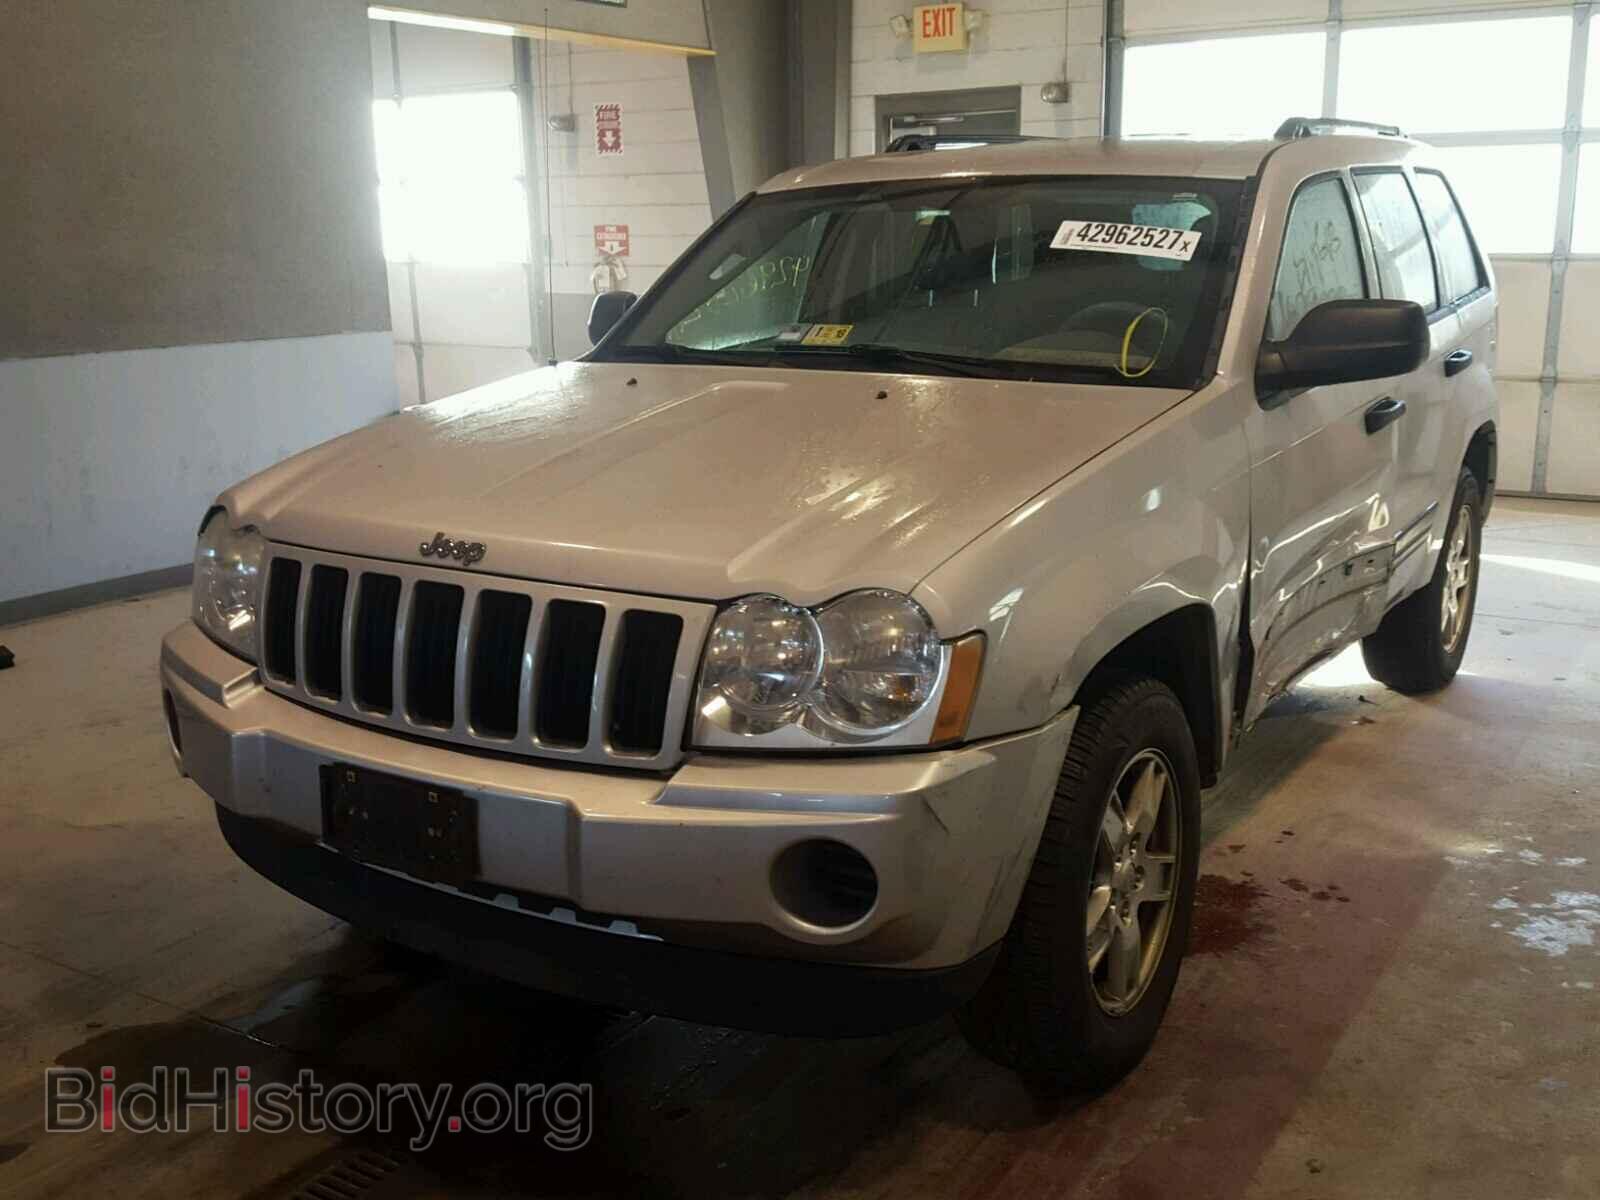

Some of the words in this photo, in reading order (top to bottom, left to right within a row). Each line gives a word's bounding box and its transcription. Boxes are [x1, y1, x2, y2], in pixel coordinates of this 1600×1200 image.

[923, 7, 956, 38] EXIT
[1076, 223, 1184, 250] 42962527
[419, 531, 487, 567] Jeep
